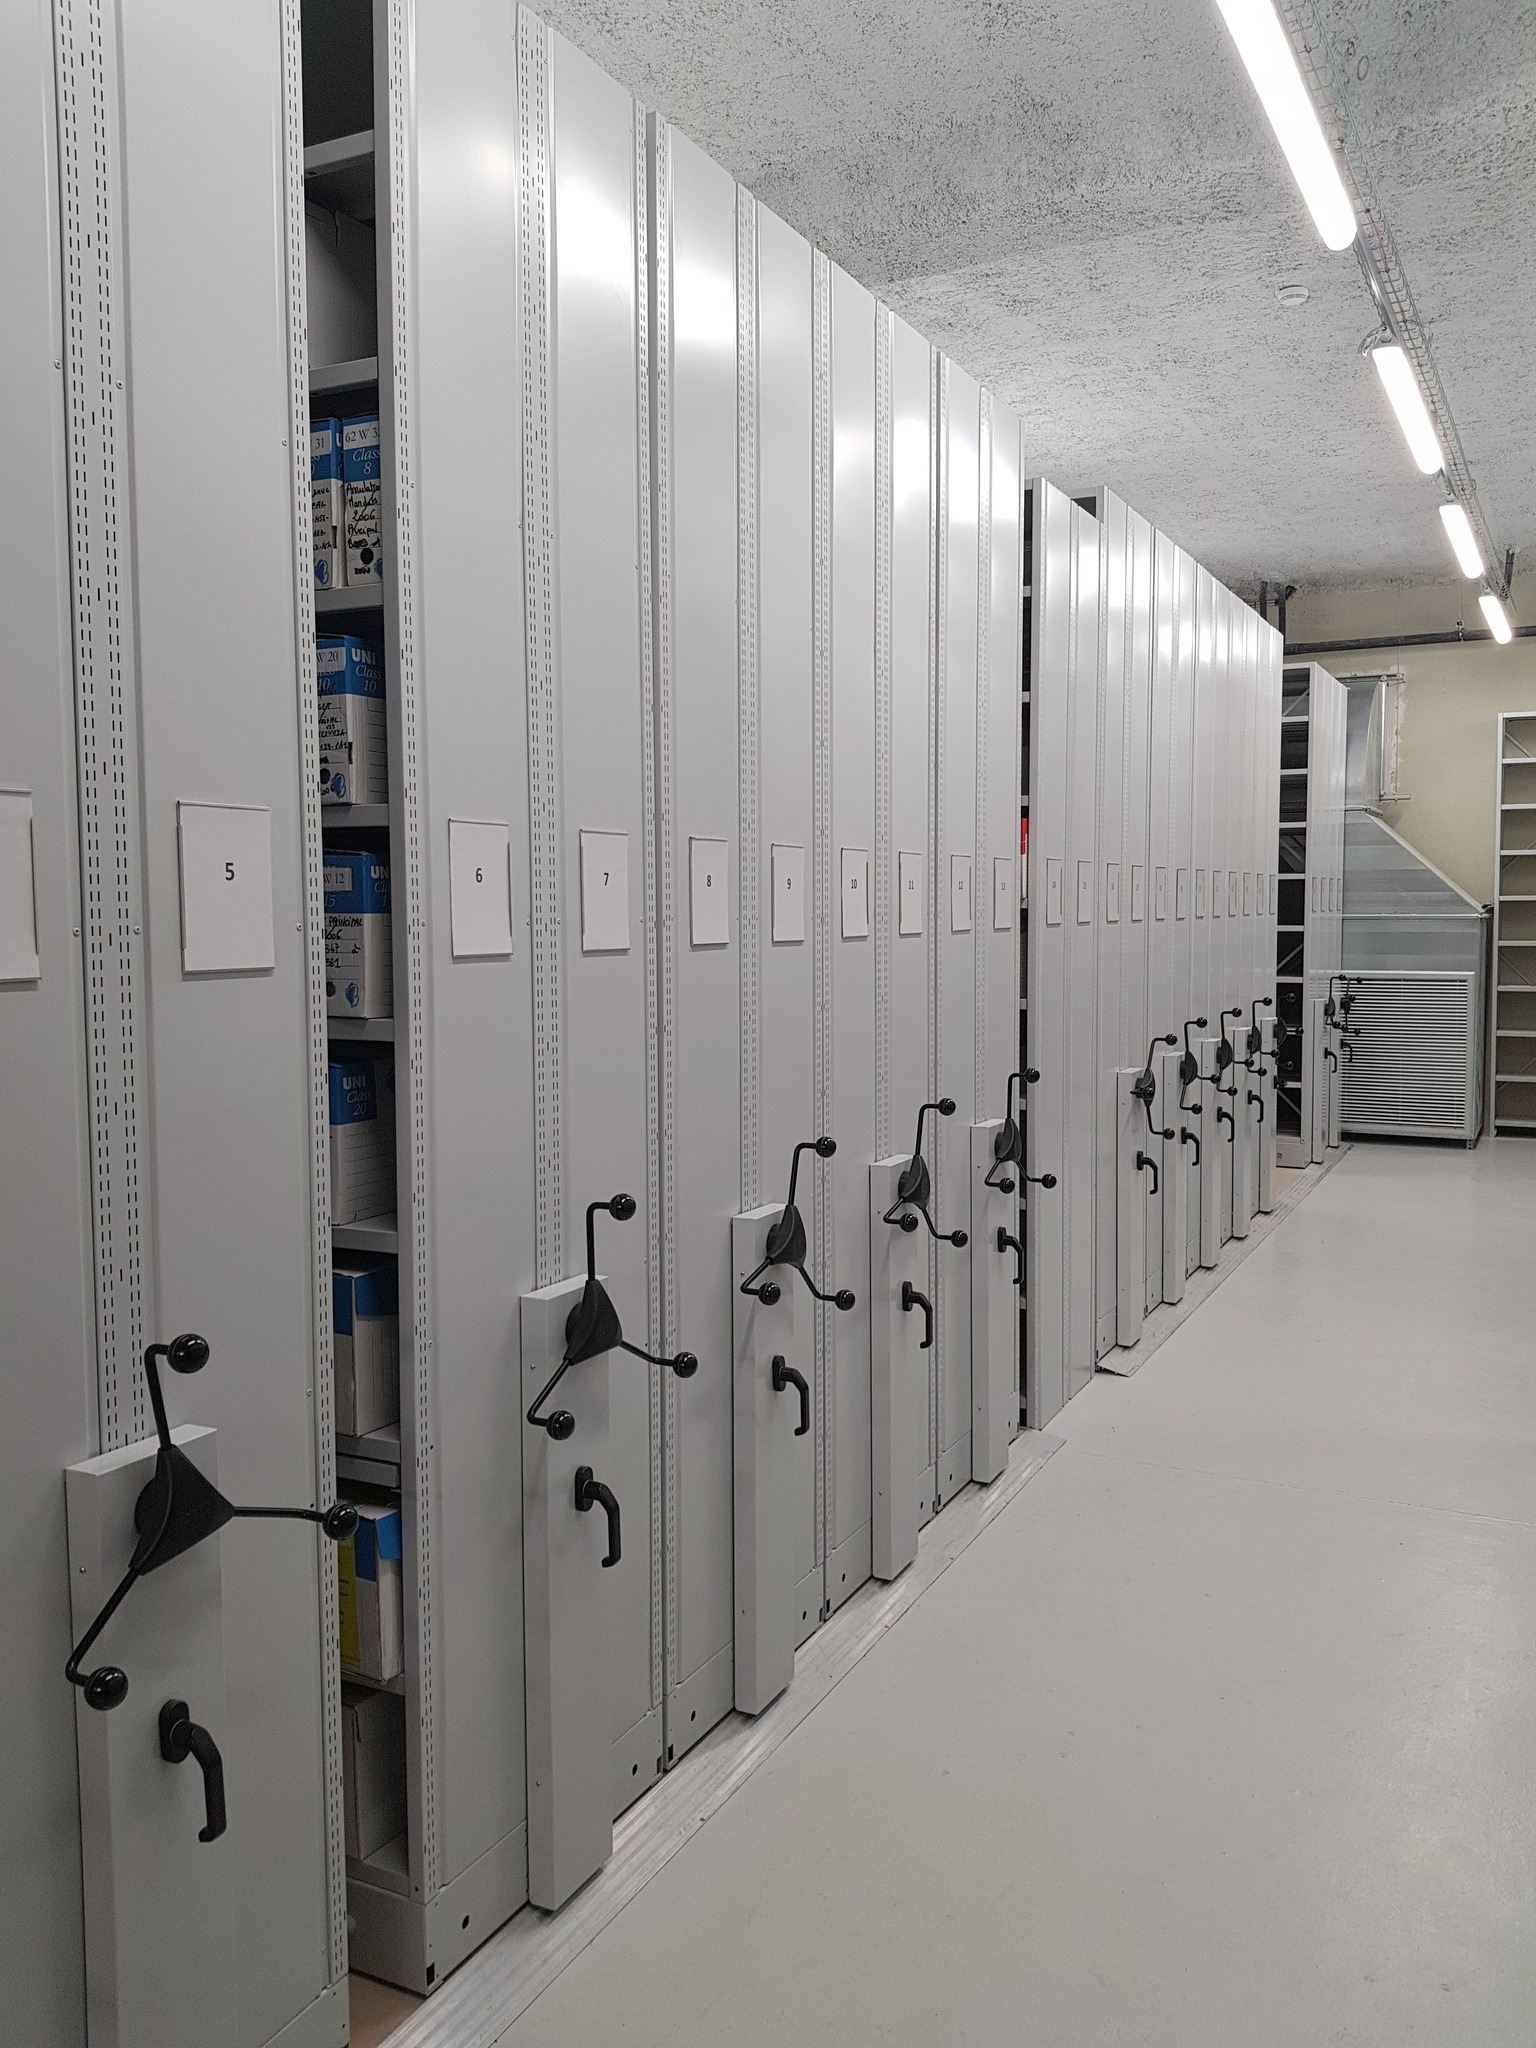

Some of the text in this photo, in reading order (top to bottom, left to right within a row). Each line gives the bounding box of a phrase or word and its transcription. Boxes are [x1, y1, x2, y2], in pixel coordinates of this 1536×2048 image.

[345, 431, 356, 442] 62
[359, 428, 369, 440] W
[363, 462, 372, 475] 8
[352, 509, 375, 521] 2006
[328, 651, 339, 662] 20
[351, 648, 376, 665] UNI
[356, 665, 382, 679] Class
[364, 680, 377, 692] 10
[225, 862, 235, 881] 5
[335, 873, 344, 884] 12
[475, 867, 483, 884] 6
[603, 872, 610, 887] 7
[706, 874, 712, 888] 8
[786, 877, 792, 890] 9
[851, 878, 858, 890] 10
[908, 880, 915, 890] 11
[958, 880, 964, 890] 12
[342, 1075, 367, 1090] UNI
[347, 1090, 372, 1104] Class
[353, 1102, 367, 1116] 20
